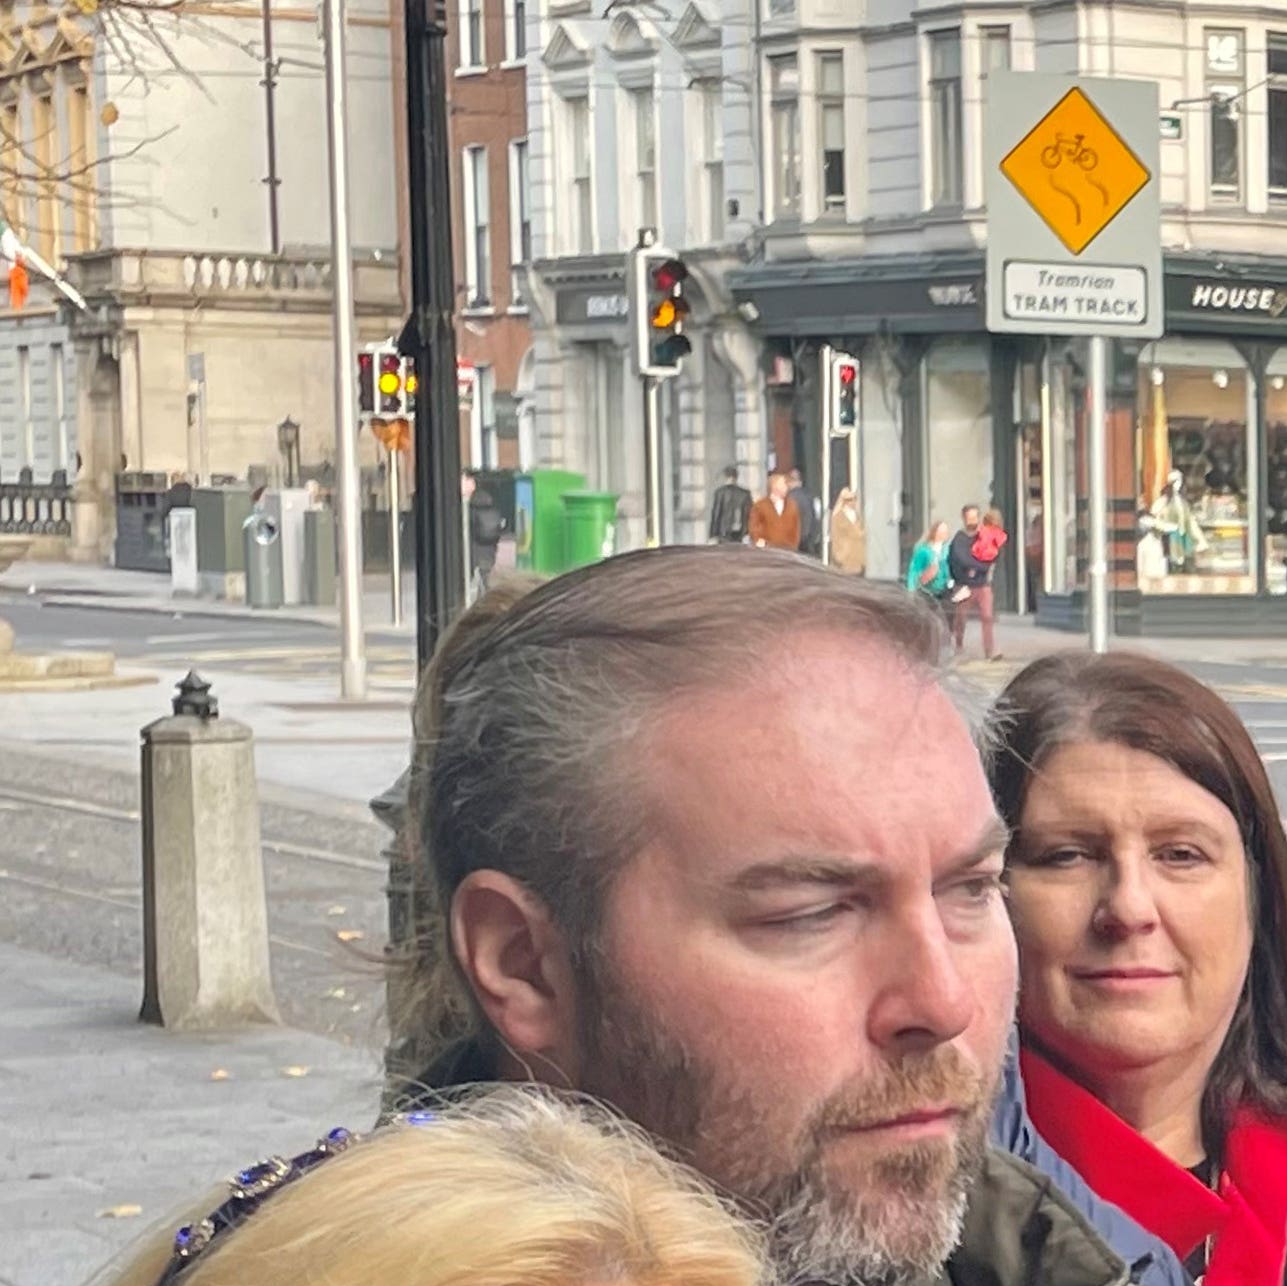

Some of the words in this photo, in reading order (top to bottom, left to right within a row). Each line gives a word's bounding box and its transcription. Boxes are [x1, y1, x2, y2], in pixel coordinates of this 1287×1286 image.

[1037, 270, 1115, 289] Tramrian
[1014, 294, 1068, 314] TRAM
[1074, 298, 1137, 316] TRACK
[1192, 285, 1275, 309] HOUSE
